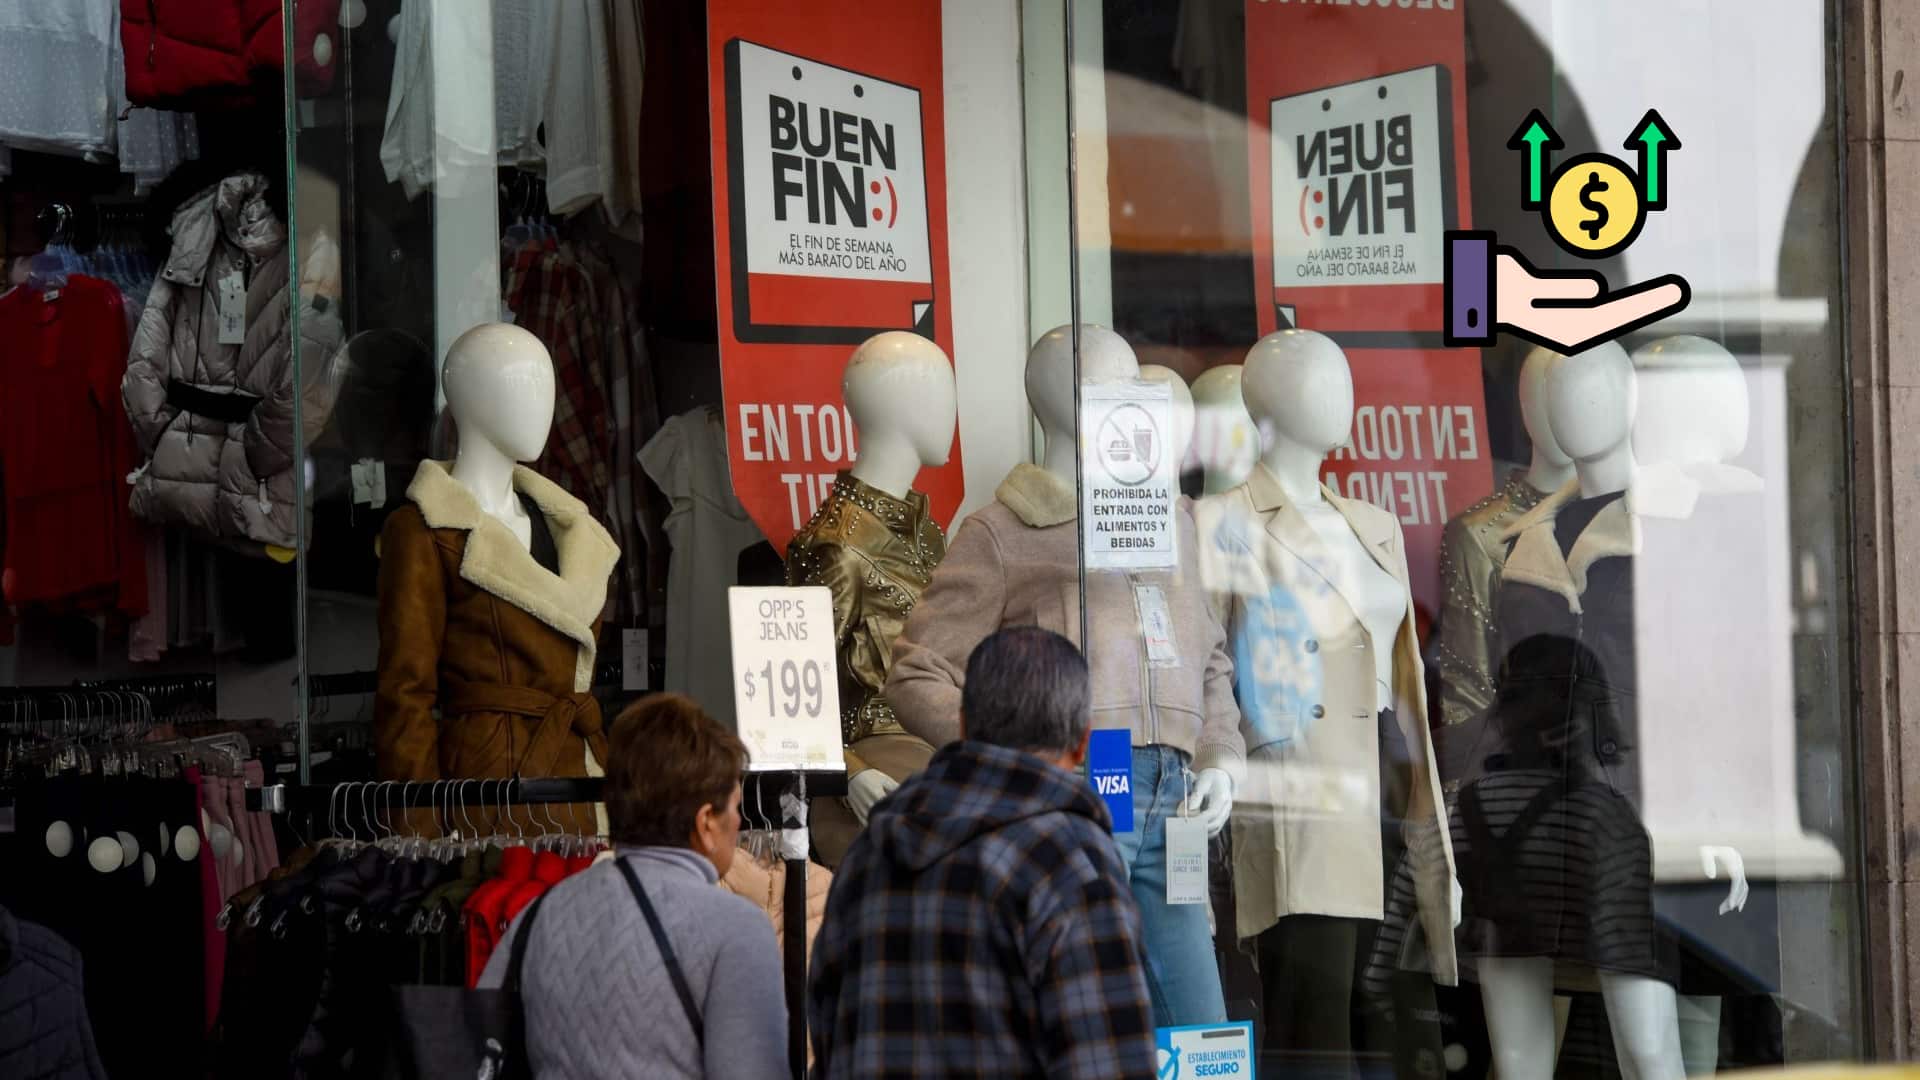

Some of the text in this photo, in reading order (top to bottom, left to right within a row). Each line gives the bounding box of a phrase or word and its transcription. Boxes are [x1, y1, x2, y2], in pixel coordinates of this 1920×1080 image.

[769, 94, 896, 171] BUEN
[790, 233, 895, 255] EL FIN DE SEMANA
[779, 247, 907, 272] MÁS BARATO DEL AÑO
[739, 404, 790, 462] EN
[1093, 488, 1167, 499] PROHIBIDA LA
[1093, 504, 1168, 516] ENTRADA CON
[1096, 521, 1167, 532] ALIMENTOS Y
[1110, 537, 1155, 548] BEBIDAS
[759, 599, 805, 619] OPP'S
[760, 621, 808, 641] JEANS
[1093, 775, 1130, 795] VISA
[1187, 1048, 1246, 1065] ESTABLECIMIENTO
[1195, 1061, 1239, 1077] SEGURO
